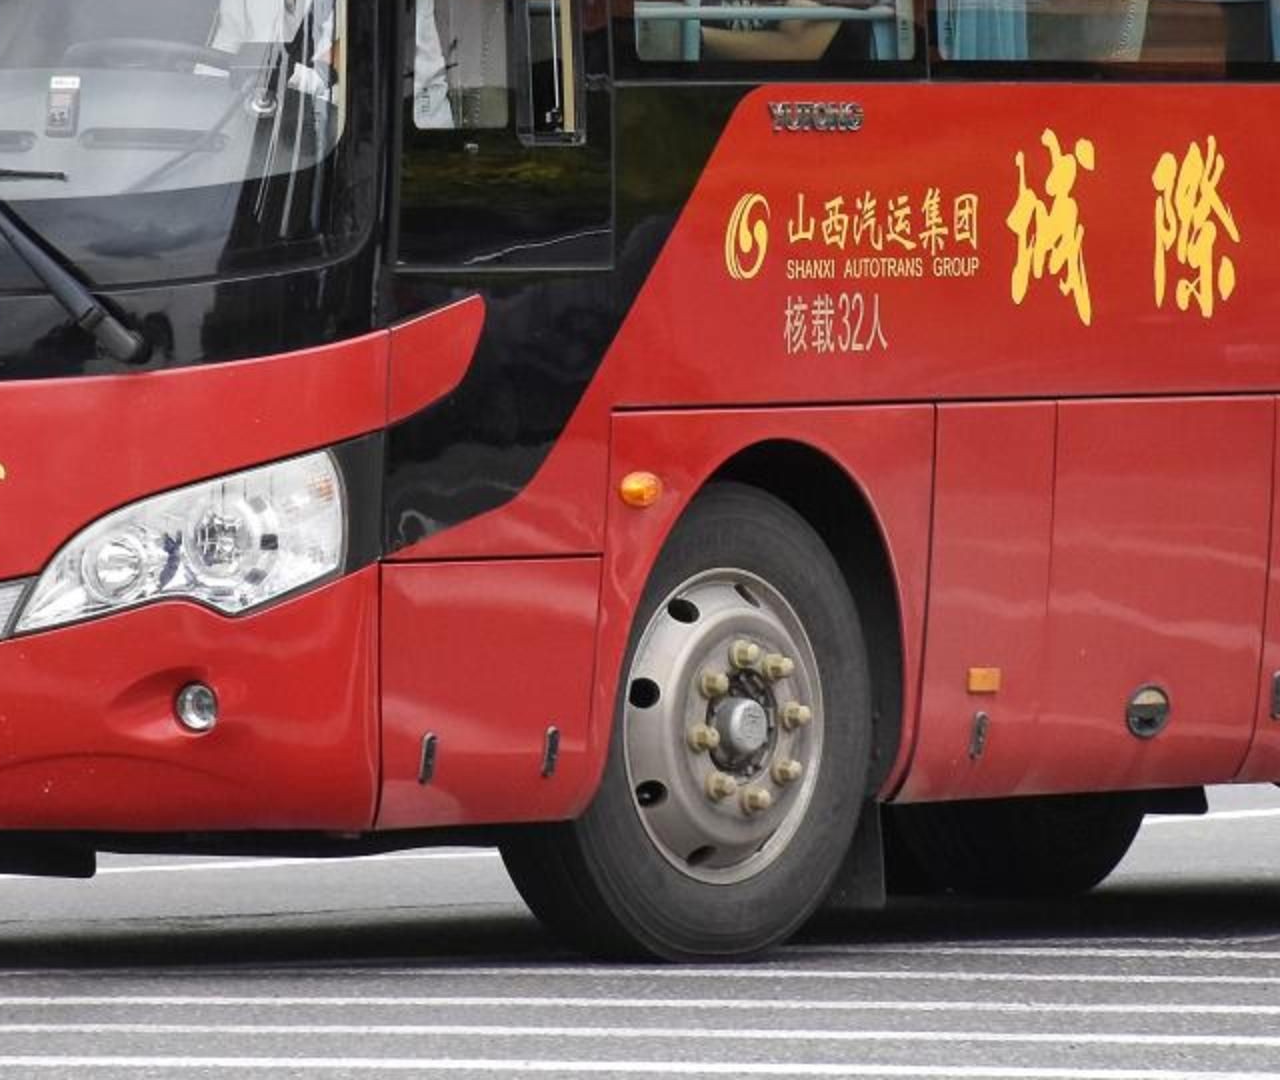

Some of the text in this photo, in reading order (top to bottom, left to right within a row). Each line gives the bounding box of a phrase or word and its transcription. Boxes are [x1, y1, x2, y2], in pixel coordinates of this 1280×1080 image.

[769, 102, 865, 131] YUTONG
[787, 188, 979, 256] 山西汽运集团
[786, 256, 980, 280] SHANXI AUTOTRANS GROUP
[783, 292, 888, 354] 核载32人
